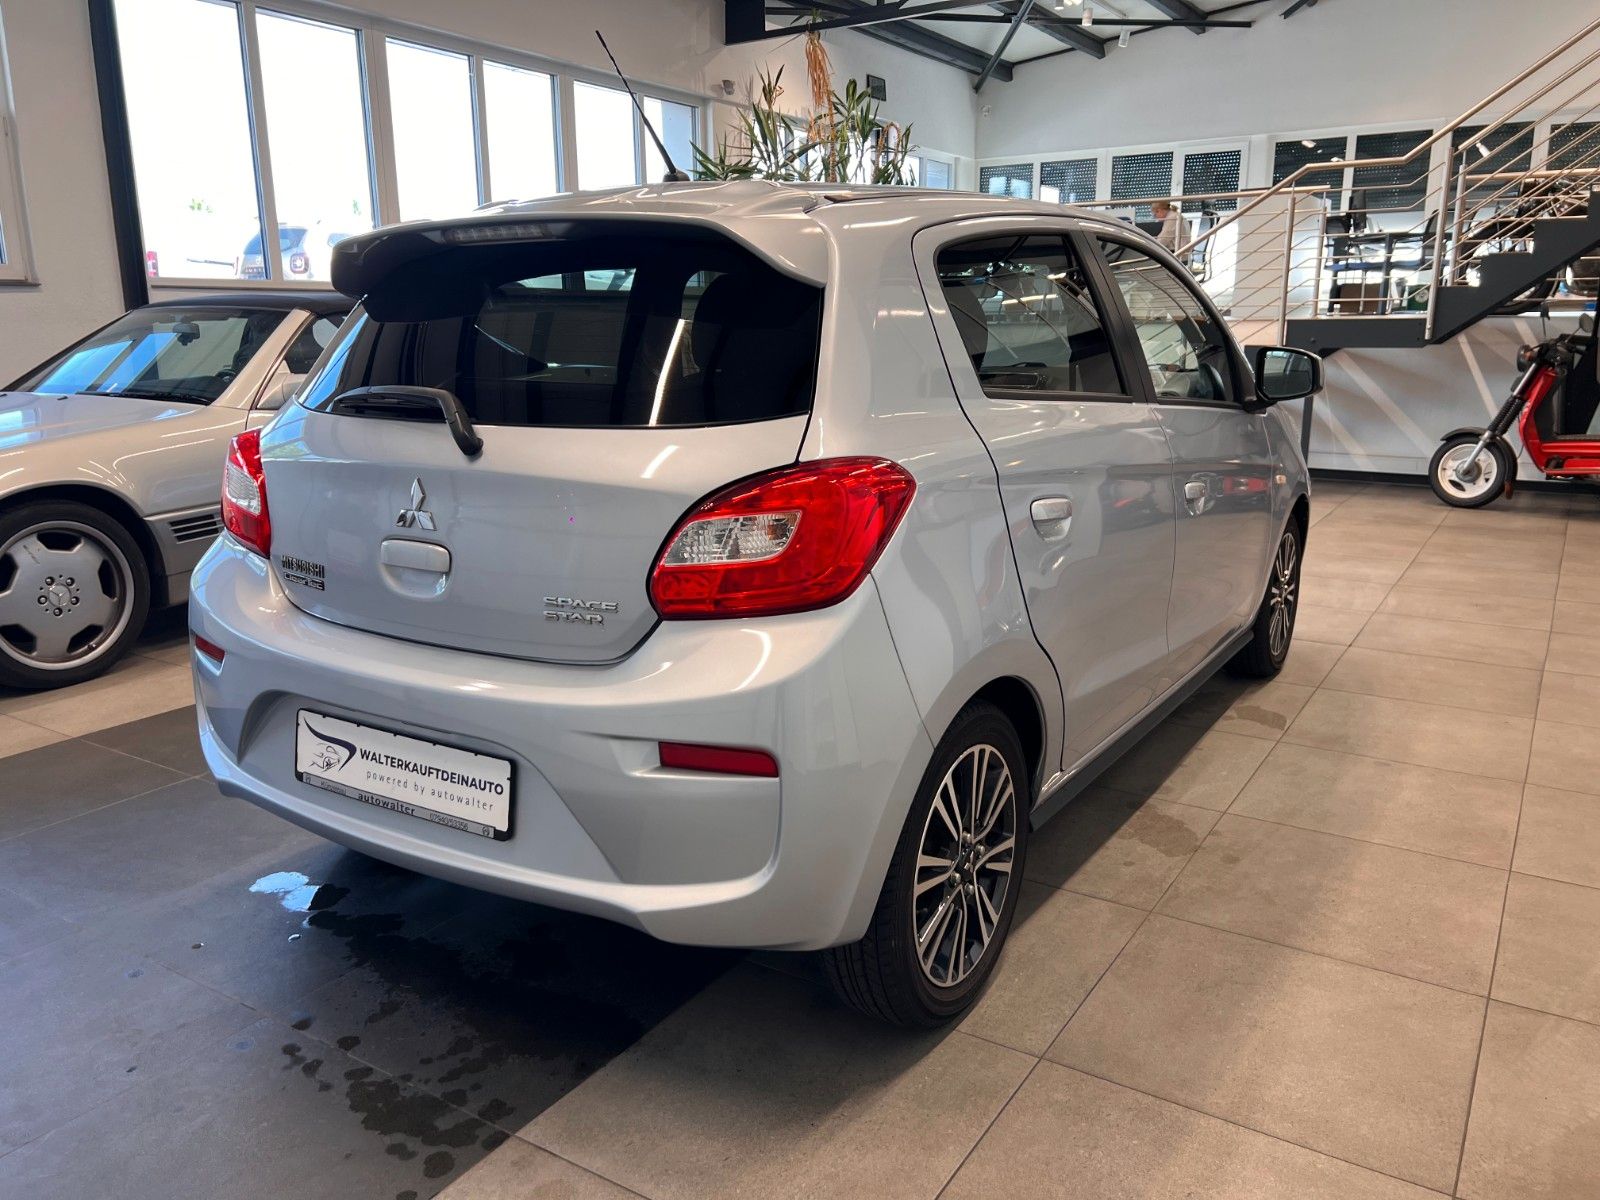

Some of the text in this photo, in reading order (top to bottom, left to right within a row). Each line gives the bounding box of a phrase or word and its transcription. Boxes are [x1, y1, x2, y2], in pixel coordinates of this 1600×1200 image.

[281, 554, 325, 579] MITSUBISHI
[542, 596, 619, 613] SPACE
[542, 610, 604, 625] STAR
[359, 748, 504, 795] WALTERKAUFTDEINAUTO
[357, 791, 416, 816] autowalter
[366, 770, 408, 789] powered
[413, 780, 426, 796] by
[430, 787, 495, 812] autowalter
